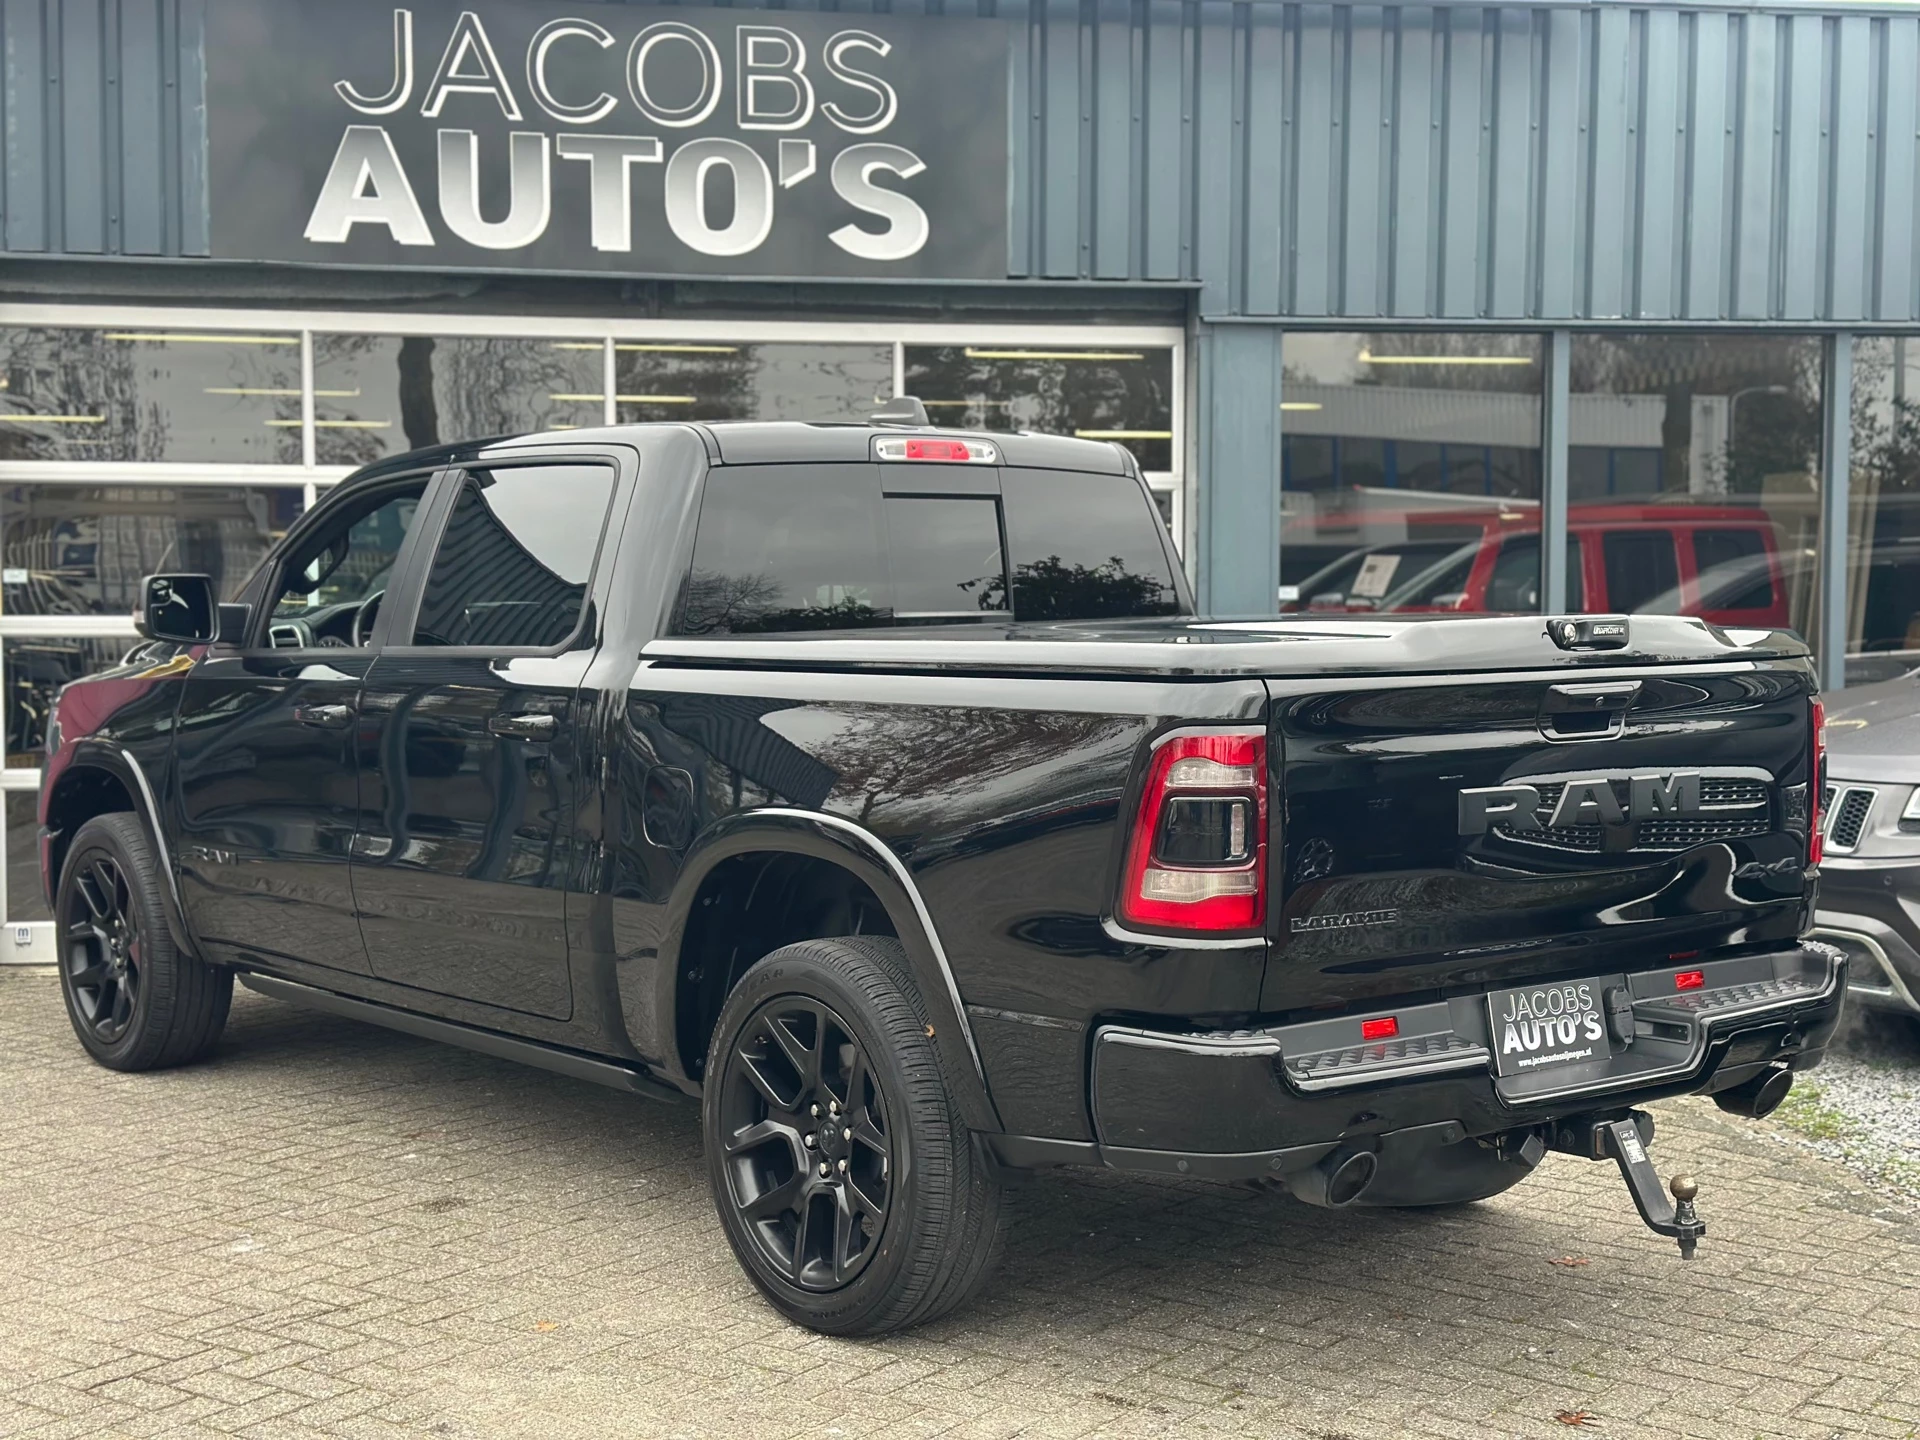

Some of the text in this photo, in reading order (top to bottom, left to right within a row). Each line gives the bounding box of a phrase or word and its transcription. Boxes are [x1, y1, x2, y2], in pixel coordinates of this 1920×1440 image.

[334, 8, 898, 134] JACOBS
[303, 125, 930, 260] AUTO'S
[1458, 771, 1700, 835] RAM
[1291, 908, 1398, 933] LARAMIE
[1502, 984, 1593, 1022] JACOBS
[1503, 1010, 1603, 1055] AUTO'S
